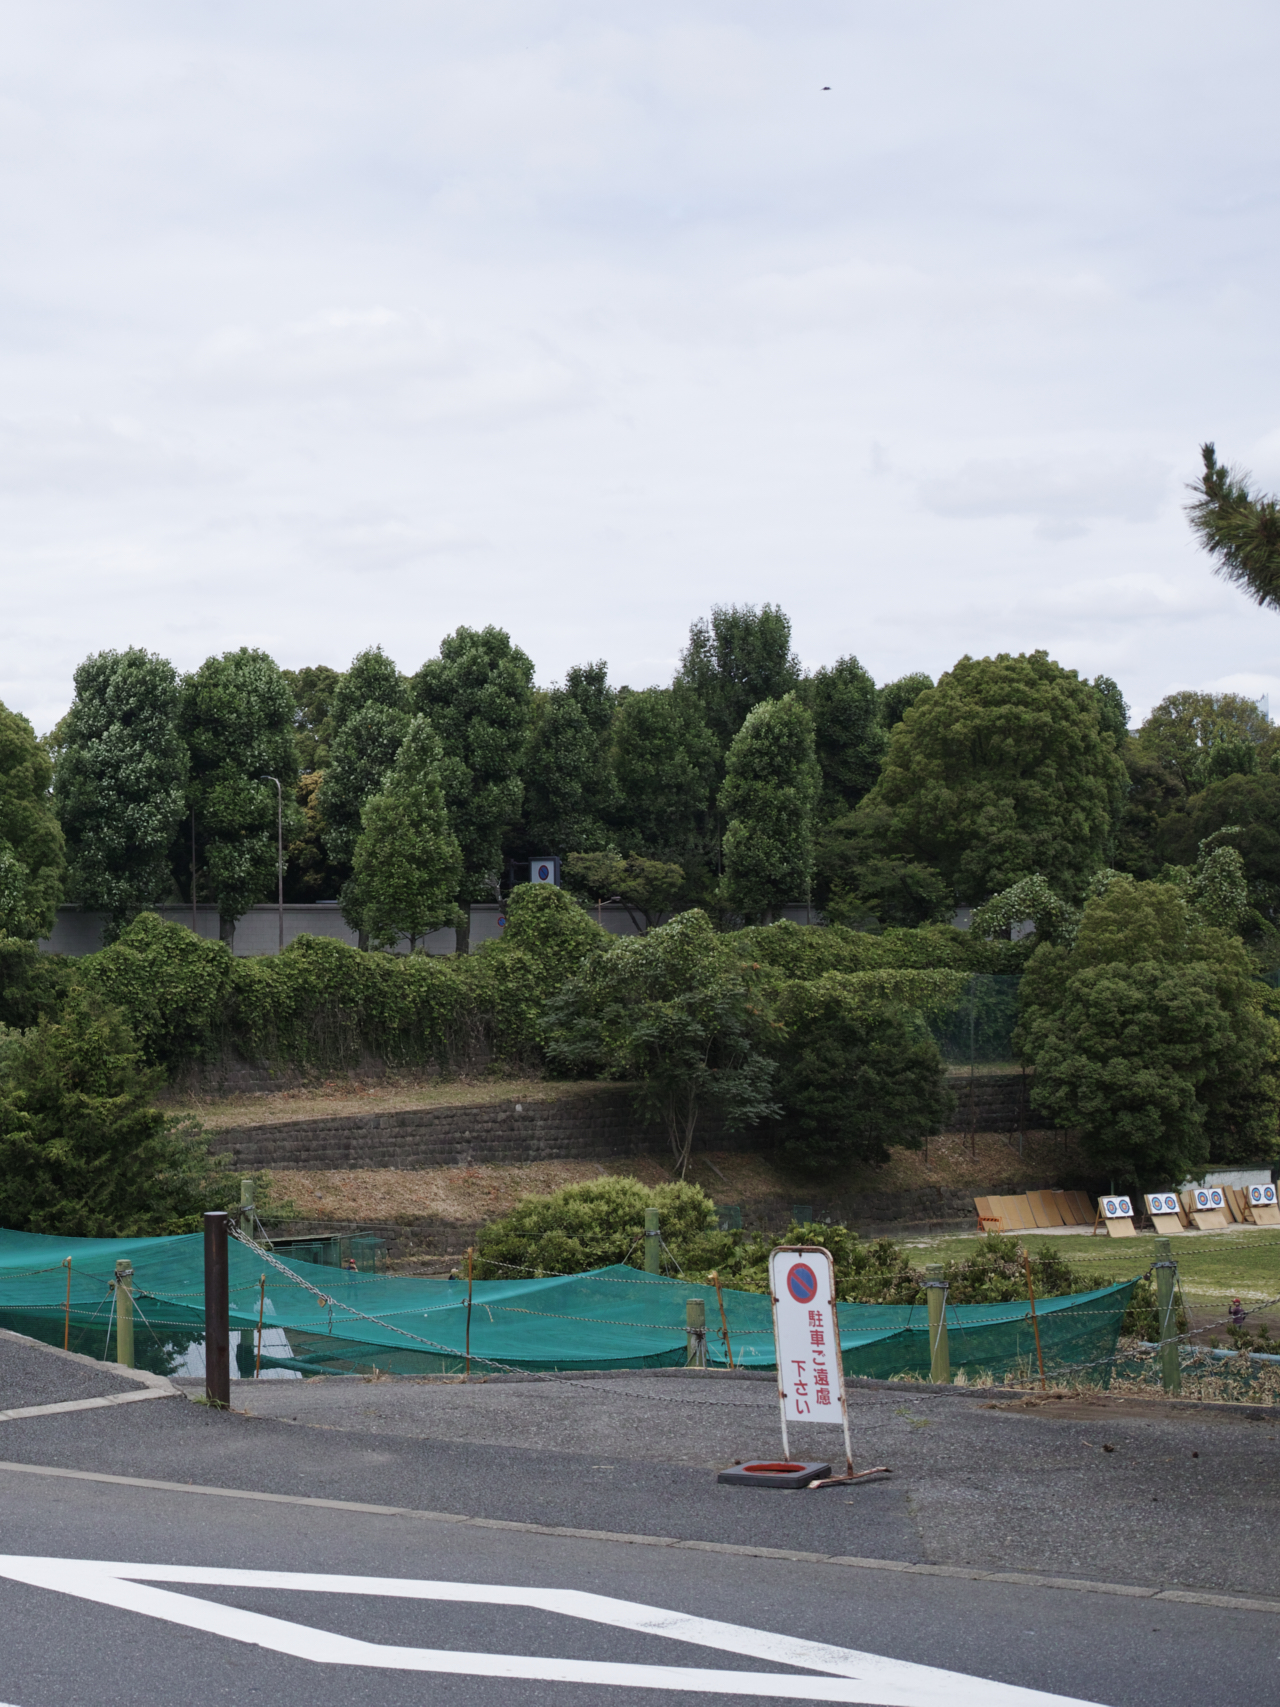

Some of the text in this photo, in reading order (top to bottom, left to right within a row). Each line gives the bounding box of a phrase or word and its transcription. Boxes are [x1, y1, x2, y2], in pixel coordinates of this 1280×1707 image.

[791, 1360, 811, 1414] 下さい
[808, 1310, 831, 1406] 駐車ご遠慮
